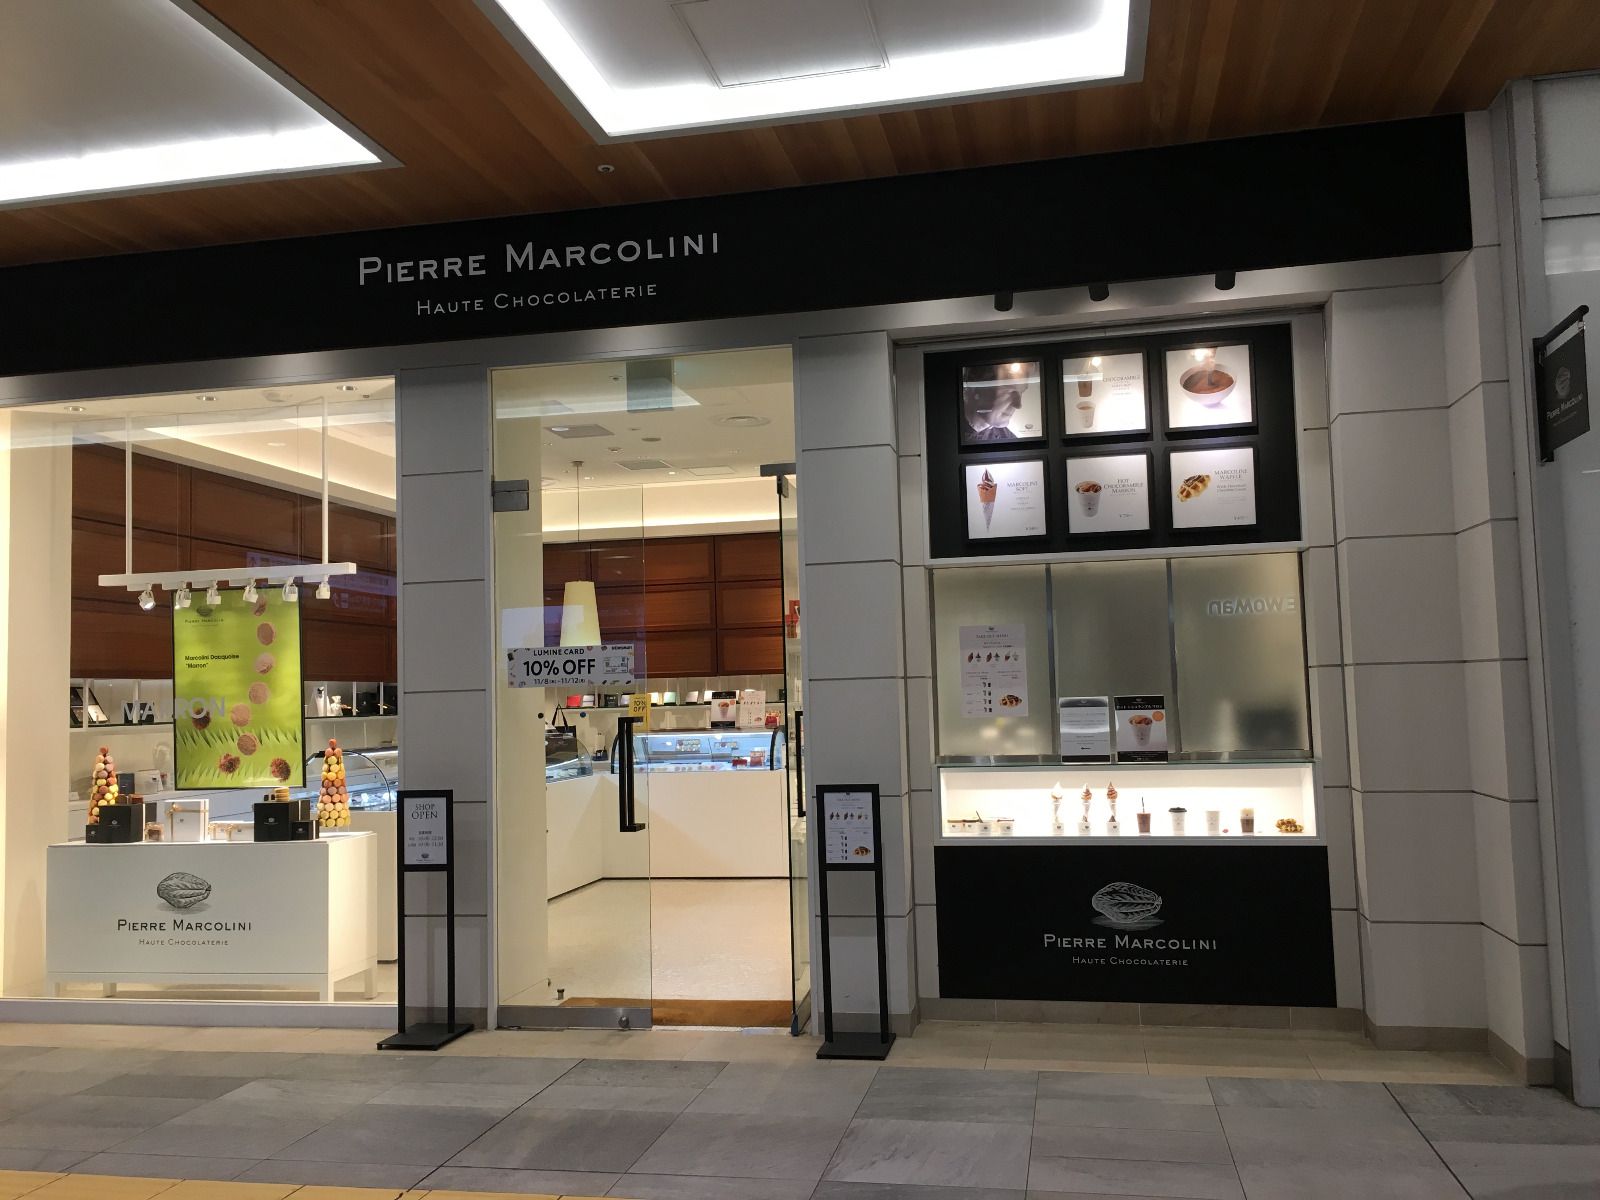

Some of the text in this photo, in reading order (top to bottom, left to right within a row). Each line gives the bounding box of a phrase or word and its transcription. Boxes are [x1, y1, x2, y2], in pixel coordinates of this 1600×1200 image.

[359, 232, 719, 286] PIERRE MARCOLINI
[416, 284, 657, 316] HAUTE CHOCOLATERIE
[523, 660, 560, 676] 10%
[562, 658, 596, 675] OFF
[121, 697, 225, 721] MARON
[411, 810, 438, 819] OPEN
[117, 919, 252, 931] PIERRE MARCOLINI
[1043, 933, 1217, 950] PIERRE MARCOLINI
[1072, 956, 1189, 966] HAUTE CHOCOLATERIE
